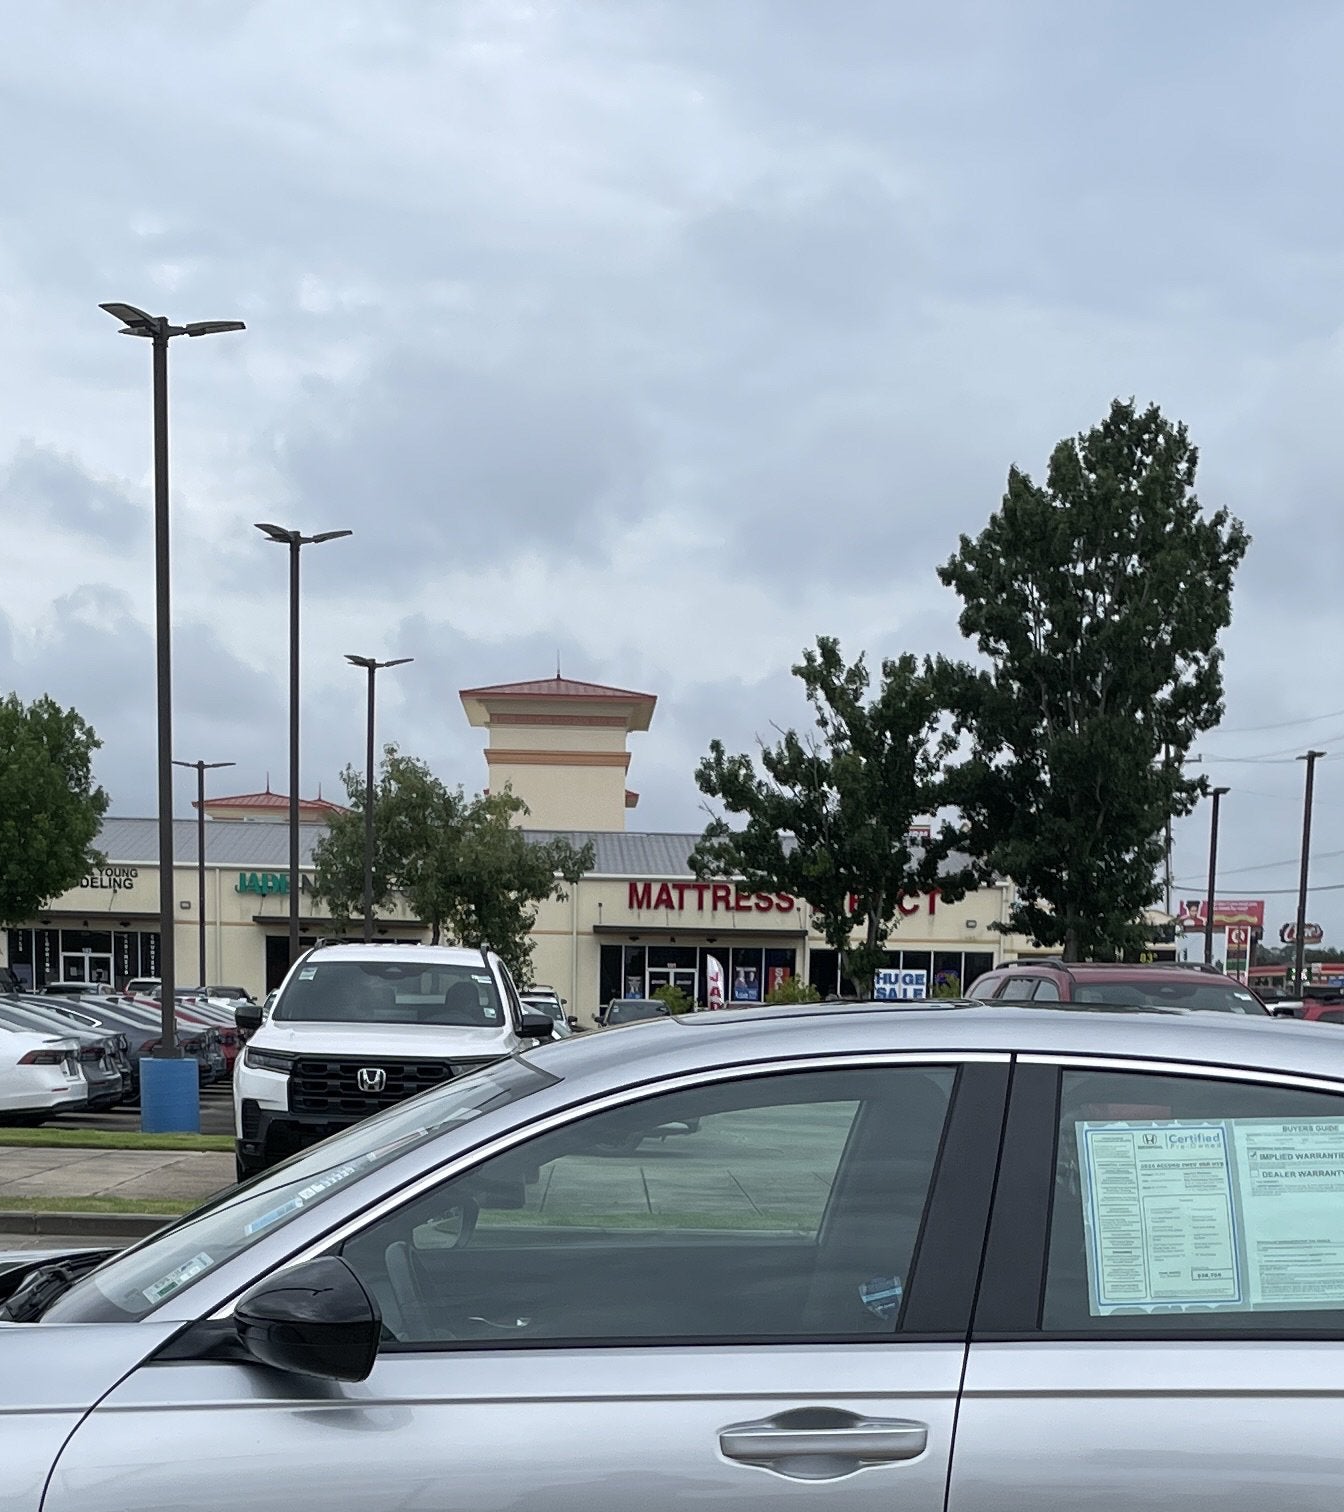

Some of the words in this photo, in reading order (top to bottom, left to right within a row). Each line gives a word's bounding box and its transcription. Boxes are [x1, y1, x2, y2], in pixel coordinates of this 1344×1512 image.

[98, 867, 139, 879] YOUNG
[80, 877, 134, 889] DELING
[234, 872, 292, 896] JADE
[627, 881, 796, 913] MATTRESS
[876, 973, 925, 985] HUGE
[875, 988, 924, 1000] SALE
[1282, 1125, 1313, 1133] BUYERS
[1168, 1132, 1220, 1144] Certified
[1262, 1170, 1297, 1178] DEALER
